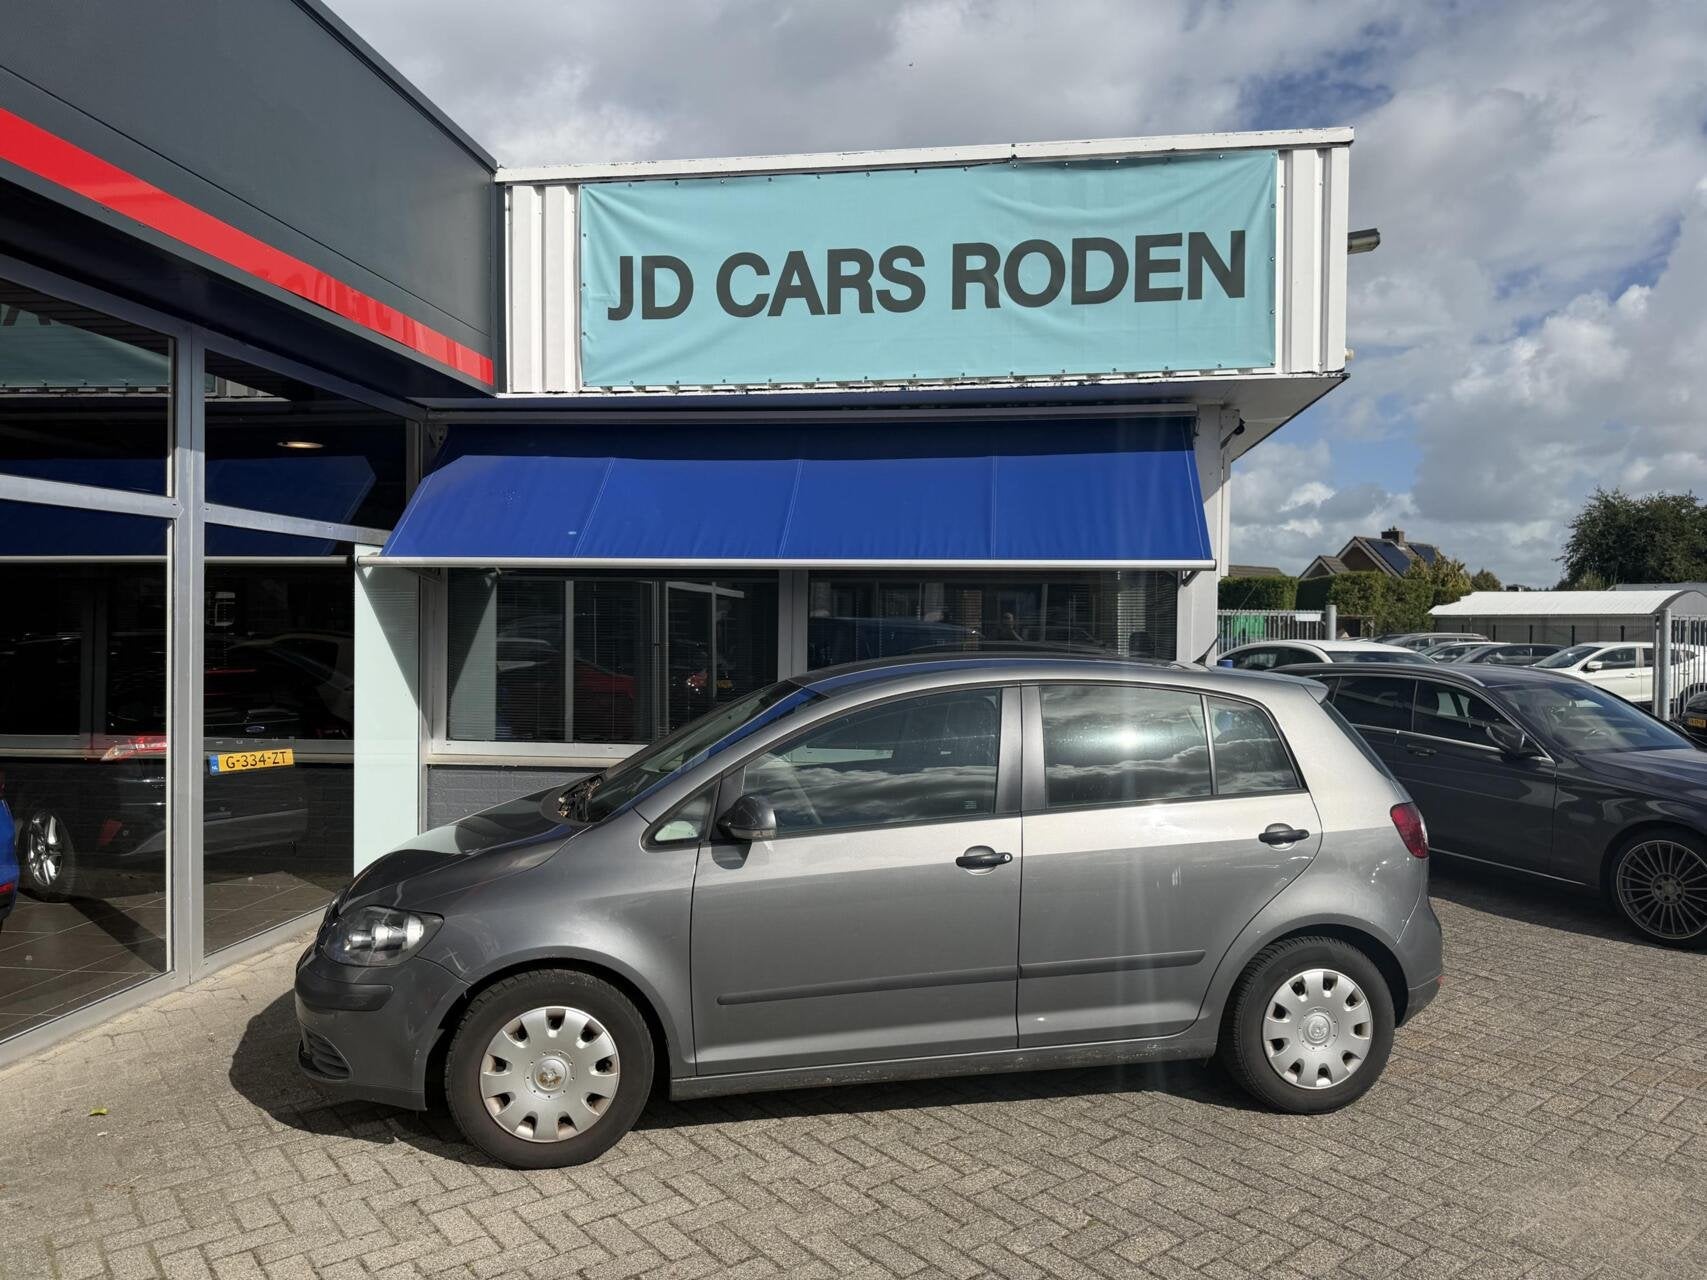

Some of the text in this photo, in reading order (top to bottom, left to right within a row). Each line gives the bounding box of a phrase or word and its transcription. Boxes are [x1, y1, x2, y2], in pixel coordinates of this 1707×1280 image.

[607, 229, 1246, 321] JD CARS RODEN
[226, 751, 287, 769] G-334-ZT
